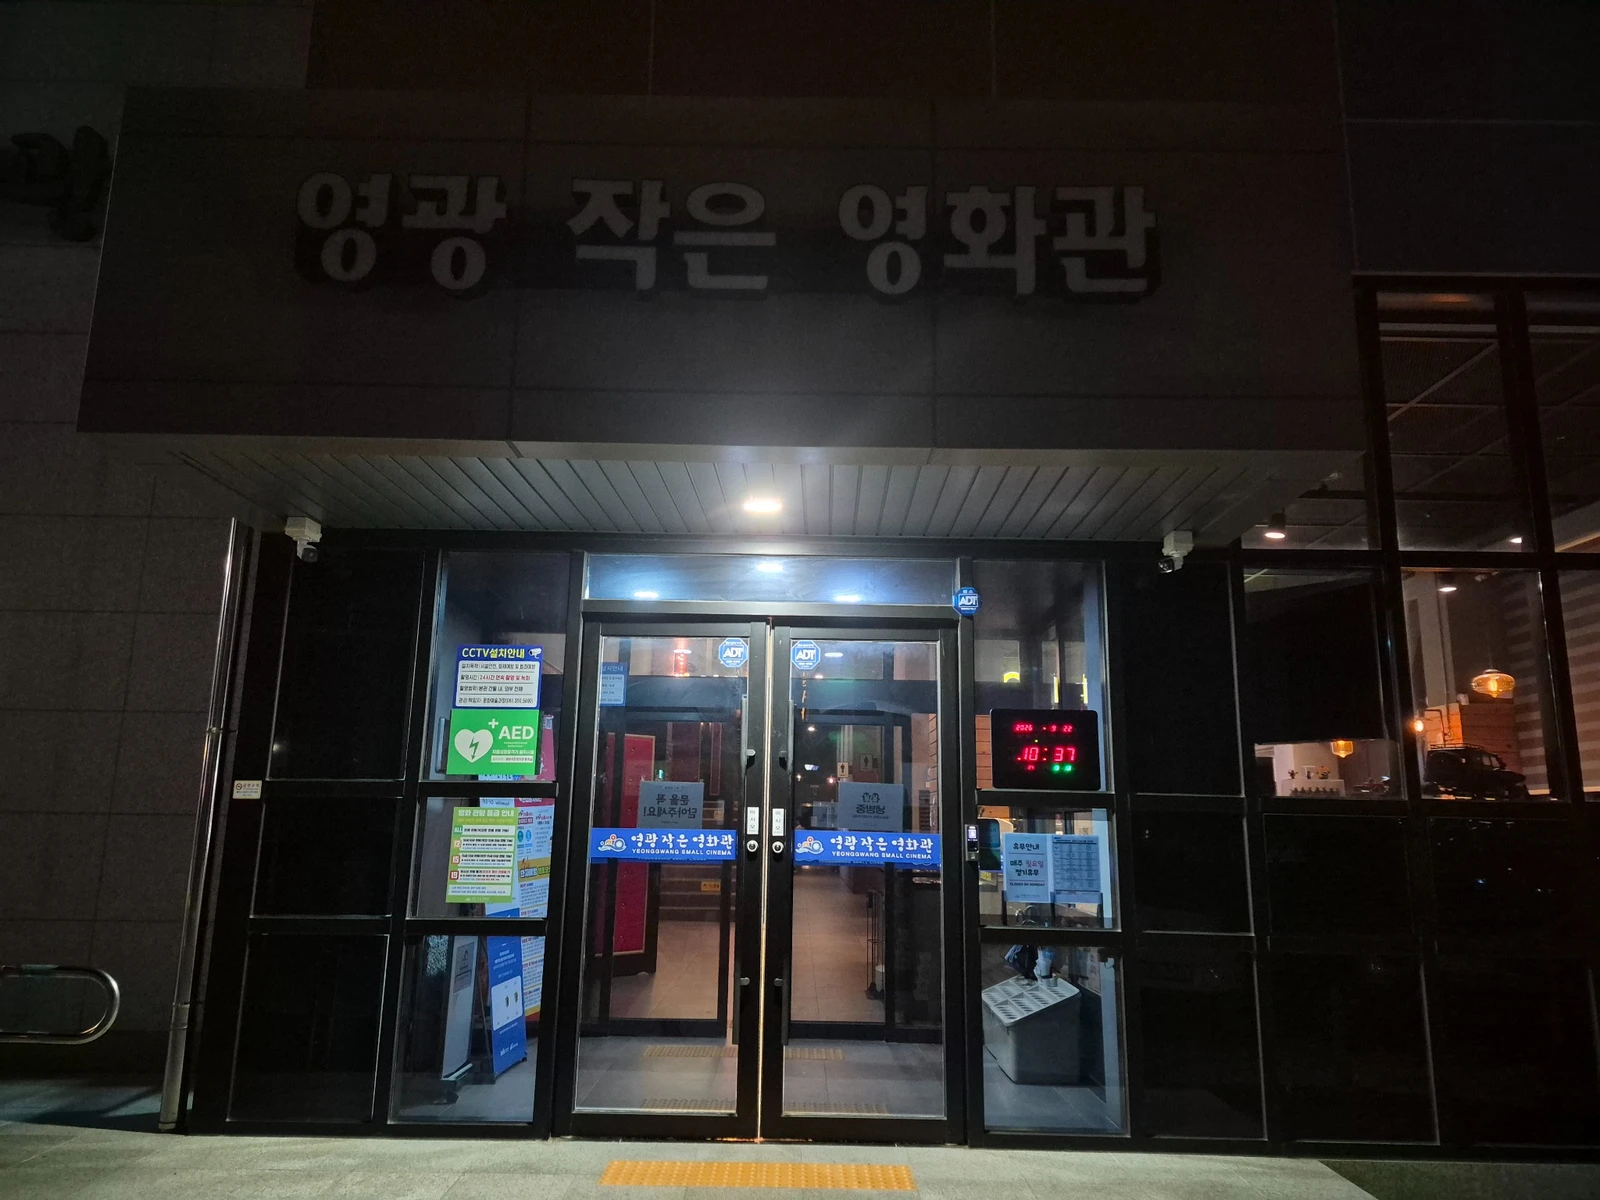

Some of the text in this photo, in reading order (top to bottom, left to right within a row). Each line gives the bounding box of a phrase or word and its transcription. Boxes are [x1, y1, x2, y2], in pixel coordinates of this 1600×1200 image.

[297, 171, 1157, 296] 영광 작은 영화관
[959, 596, 977, 606] ADT
[462, 647, 525, 659] CCTV설치안내
[723, 647, 743, 658] ADT
[796, 649, 816, 660] ADT
[498, 725, 534, 740] AED
[630, 832, 734, 850] 영광 작은 영화관
[830, 834, 933, 854] 영광 작은 영화관
[1013, 842, 1040, 851] 휴무안내
[1015, 868, 1040, 877] 정기휴무
